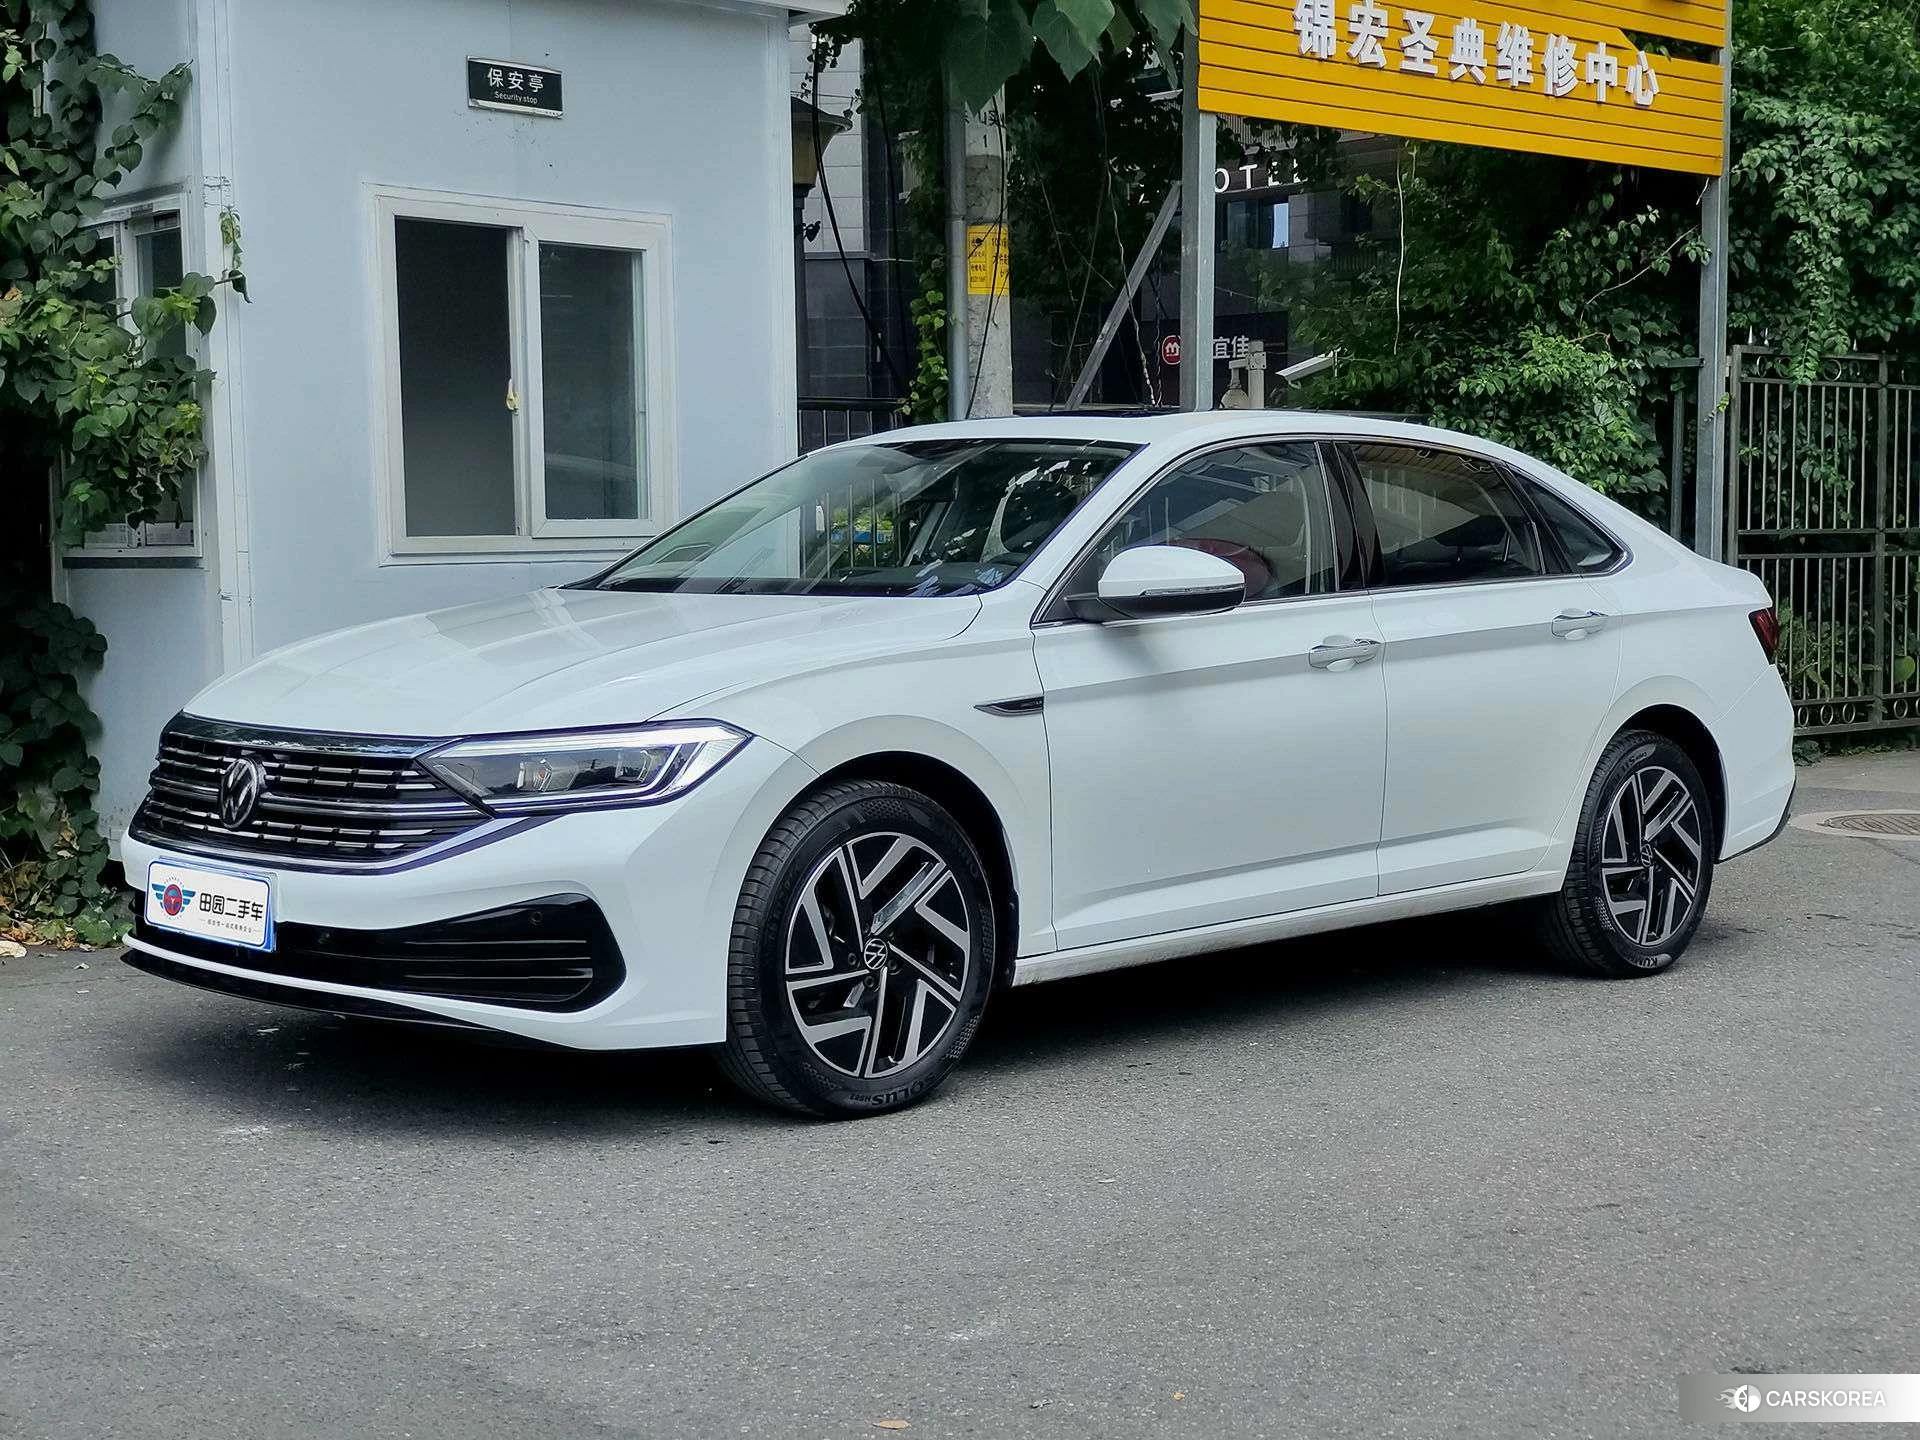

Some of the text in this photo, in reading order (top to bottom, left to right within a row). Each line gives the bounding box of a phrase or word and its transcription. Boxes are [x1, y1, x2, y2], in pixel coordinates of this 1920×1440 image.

[1293, 0, 1660, 106] 锦宏圣典维修中心
[487, 67, 544, 93] 保安亭
[494, 91, 538, 104] Security stop
[199, 892, 264, 921] 田园二手车
